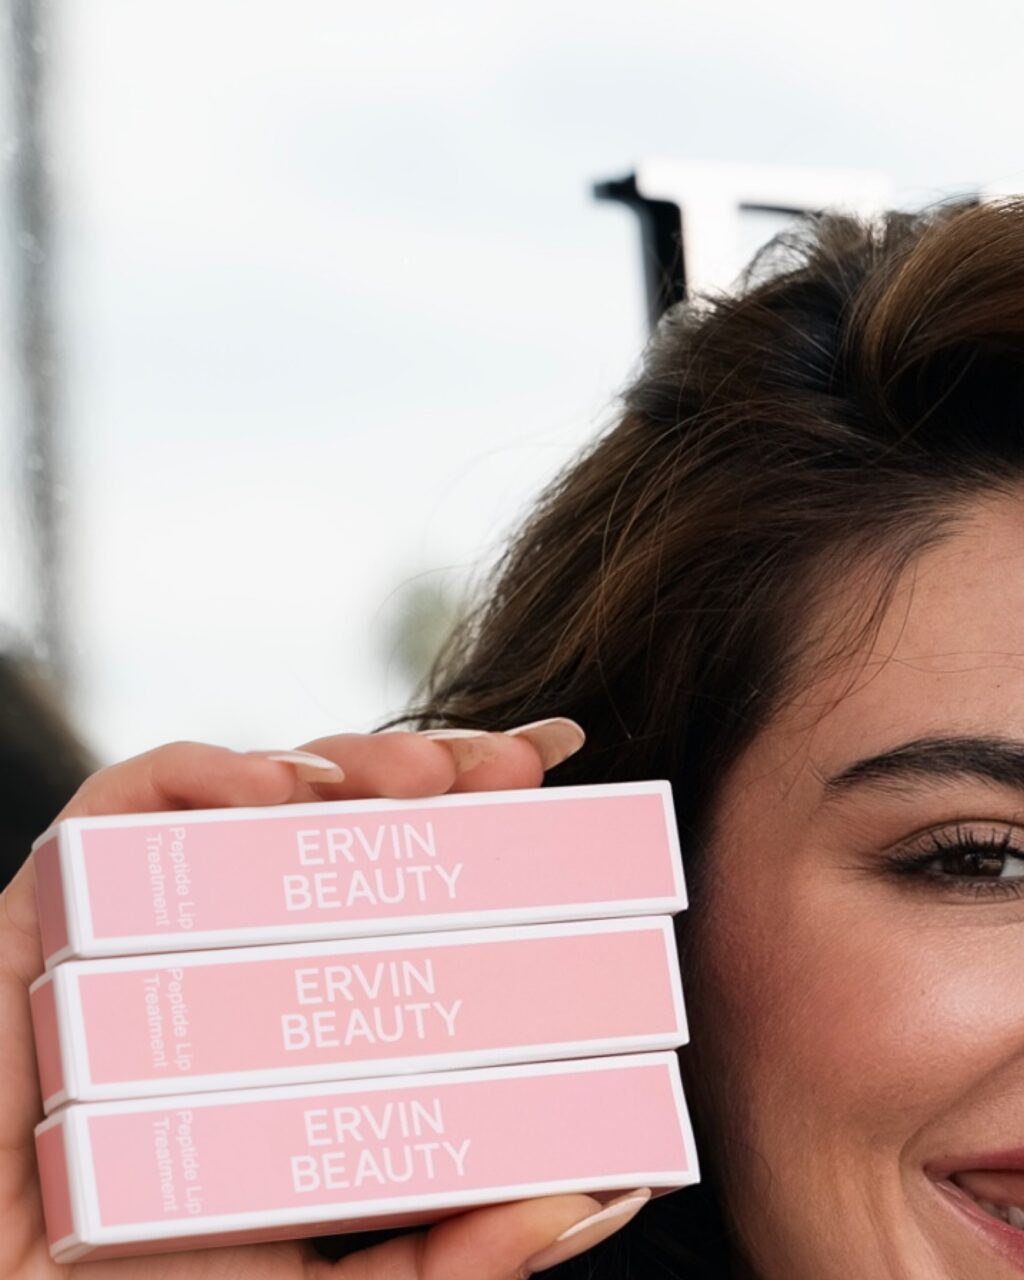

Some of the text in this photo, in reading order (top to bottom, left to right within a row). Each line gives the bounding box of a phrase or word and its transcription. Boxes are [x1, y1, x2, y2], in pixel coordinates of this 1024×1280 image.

[145, 832, 170, 926] Treatment
[169, 827, 195, 930] Peptide Lip
[296, 822, 436, 866] ERVIN
[283, 863, 463, 911] BEAUTY
[166, 967, 193, 1071] Peptide Lip
[294, 959, 435, 1005] ERVIN
[143, 973, 168, 1069] Treatment
[281, 1000, 463, 1051] BEAUTY
[304, 1099, 445, 1147] ERVIN
[152, 1116, 178, 1213] Treatment
[175, 1110, 203, 1215] Peptide Lip
[290, 1139, 471, 1193] BEAUTY
